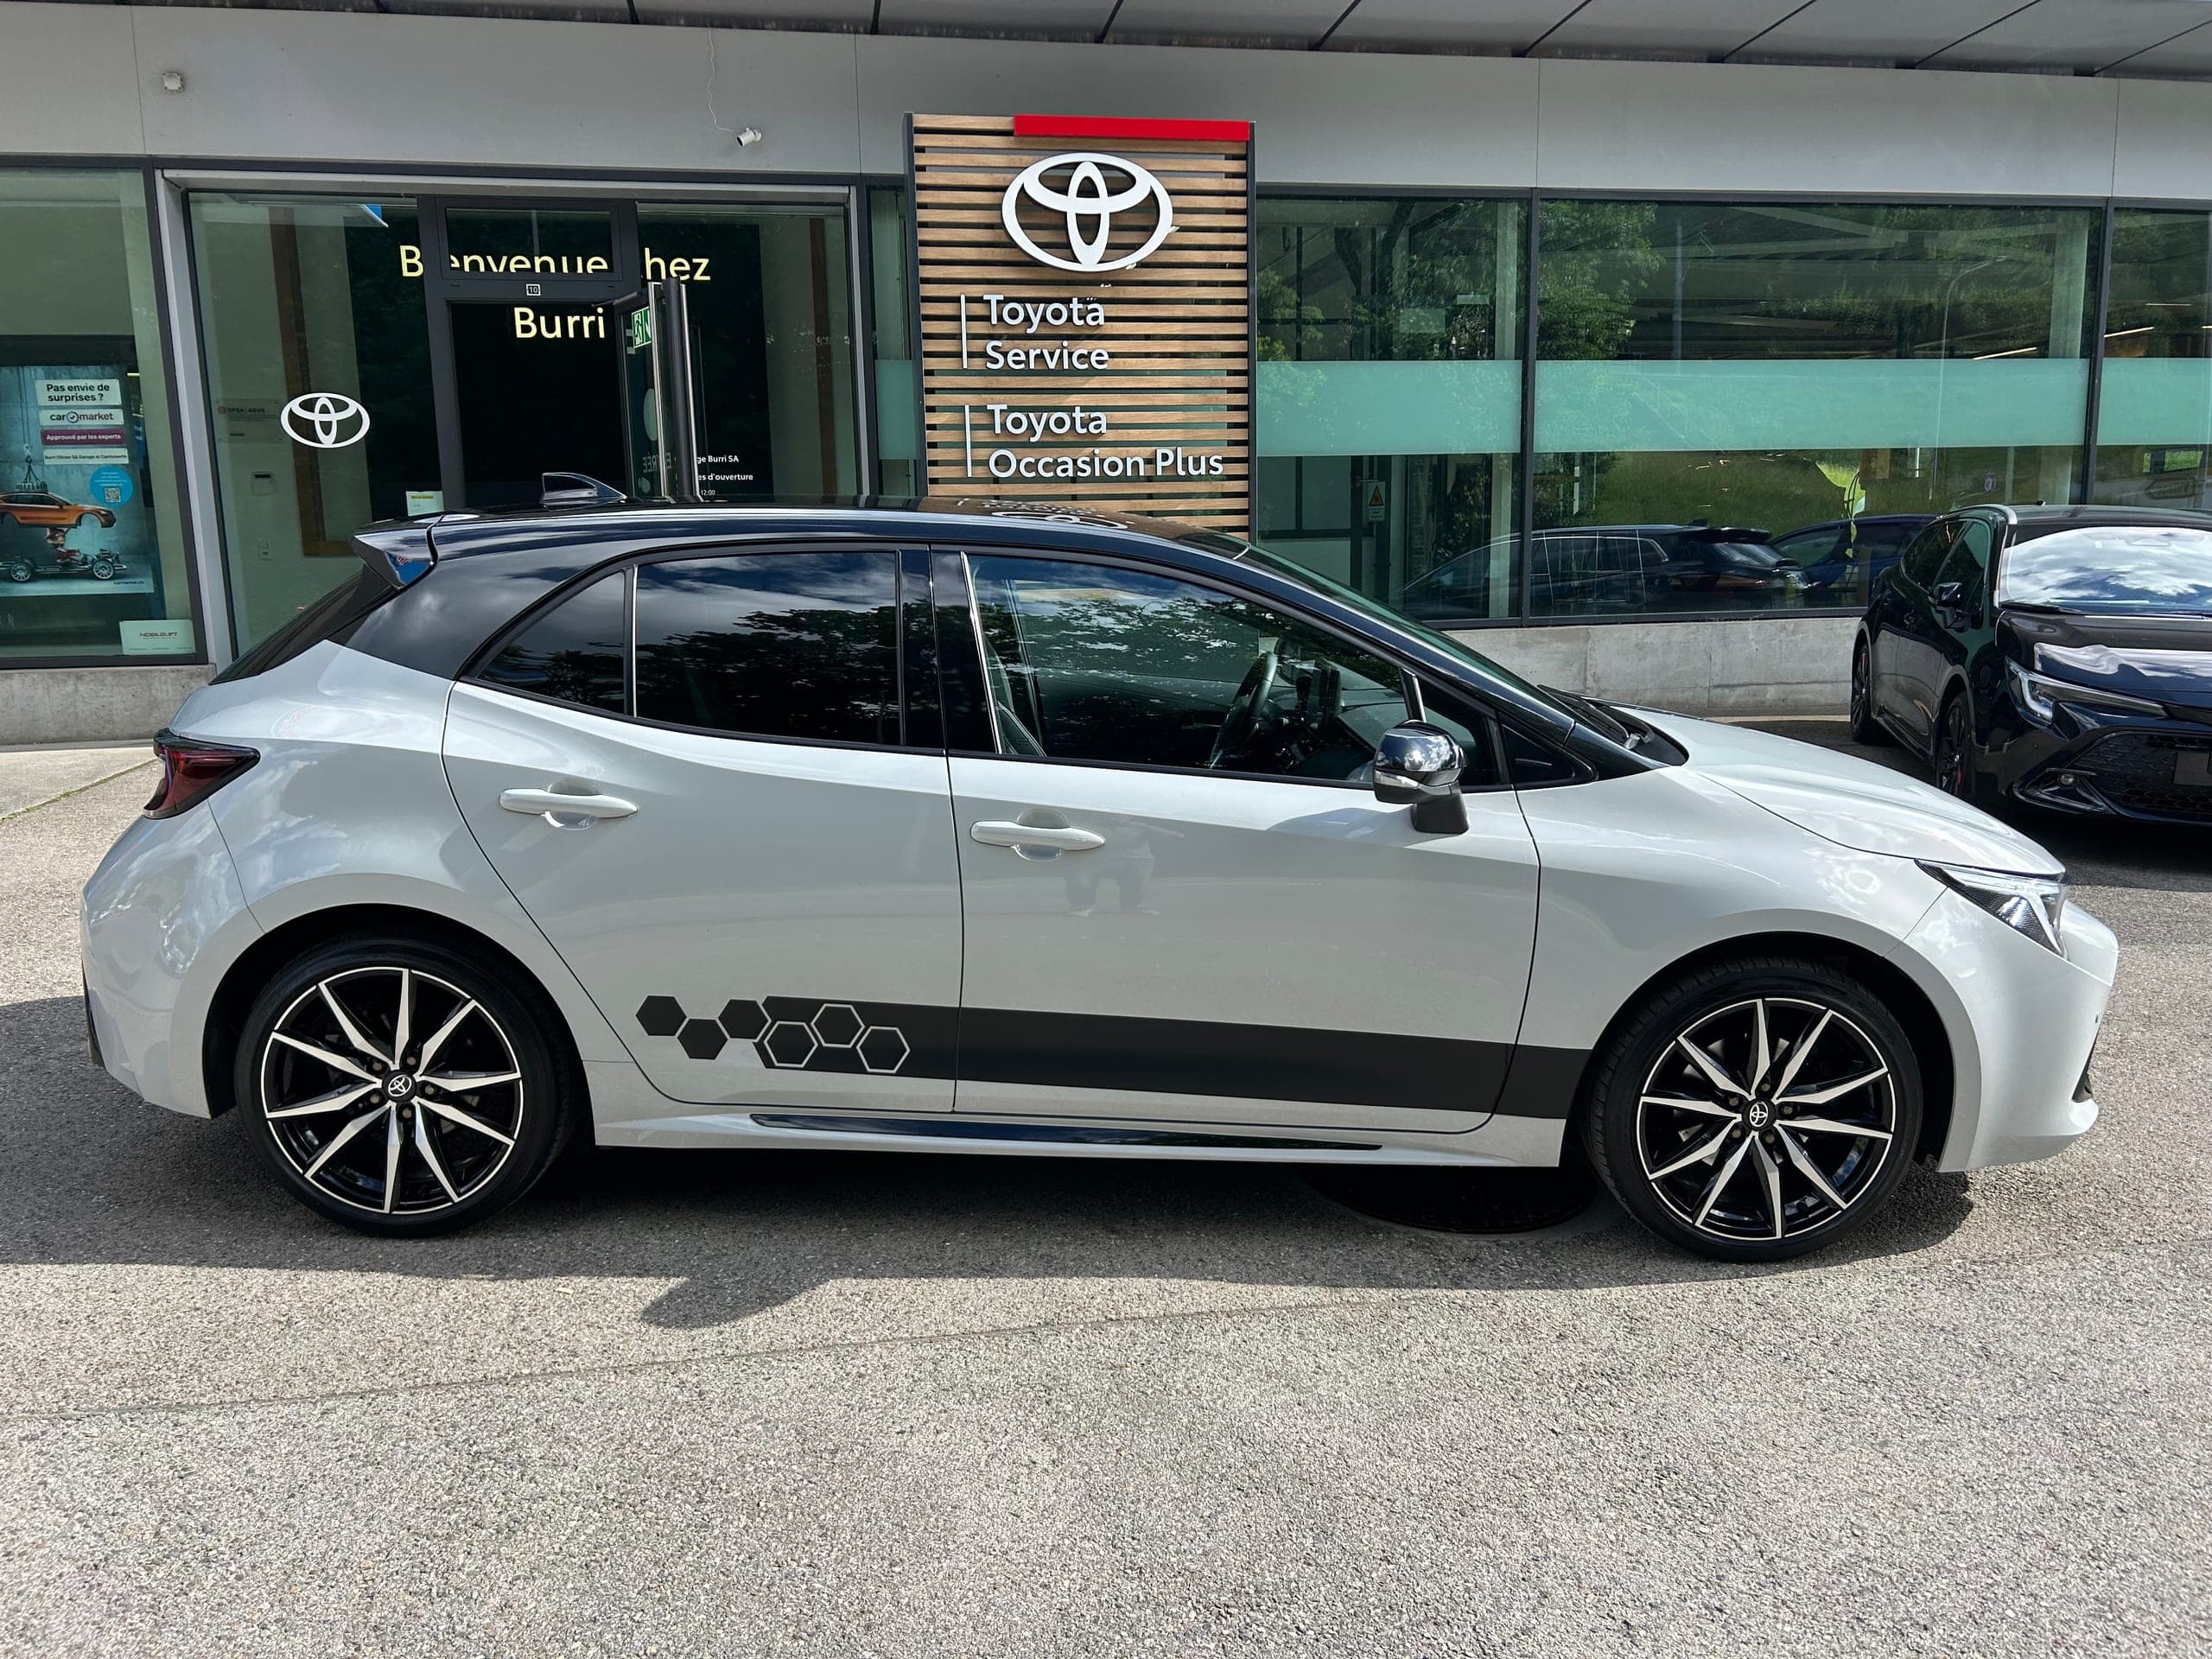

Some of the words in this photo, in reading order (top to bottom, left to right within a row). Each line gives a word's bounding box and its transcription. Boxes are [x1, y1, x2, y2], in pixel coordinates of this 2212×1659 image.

[645, 247, 711, 282] hez
[513, 307, 606, 339] Burri
[983, 295, 1105, 334] Toyota
[985, 340, 1109, 370] Service
[47, 384, 66, 392] Pas
[67, 383, 95, 391] envie
[97, 383, 110, 391] de
[48, 393, 97, 403] surprises
[98, 393, 105, 402] ?
[987, 404, 1107, 442] Toyota
[988, 448, 1145, 478] Occasion
[1155, 447, 1224, 476] Plus
